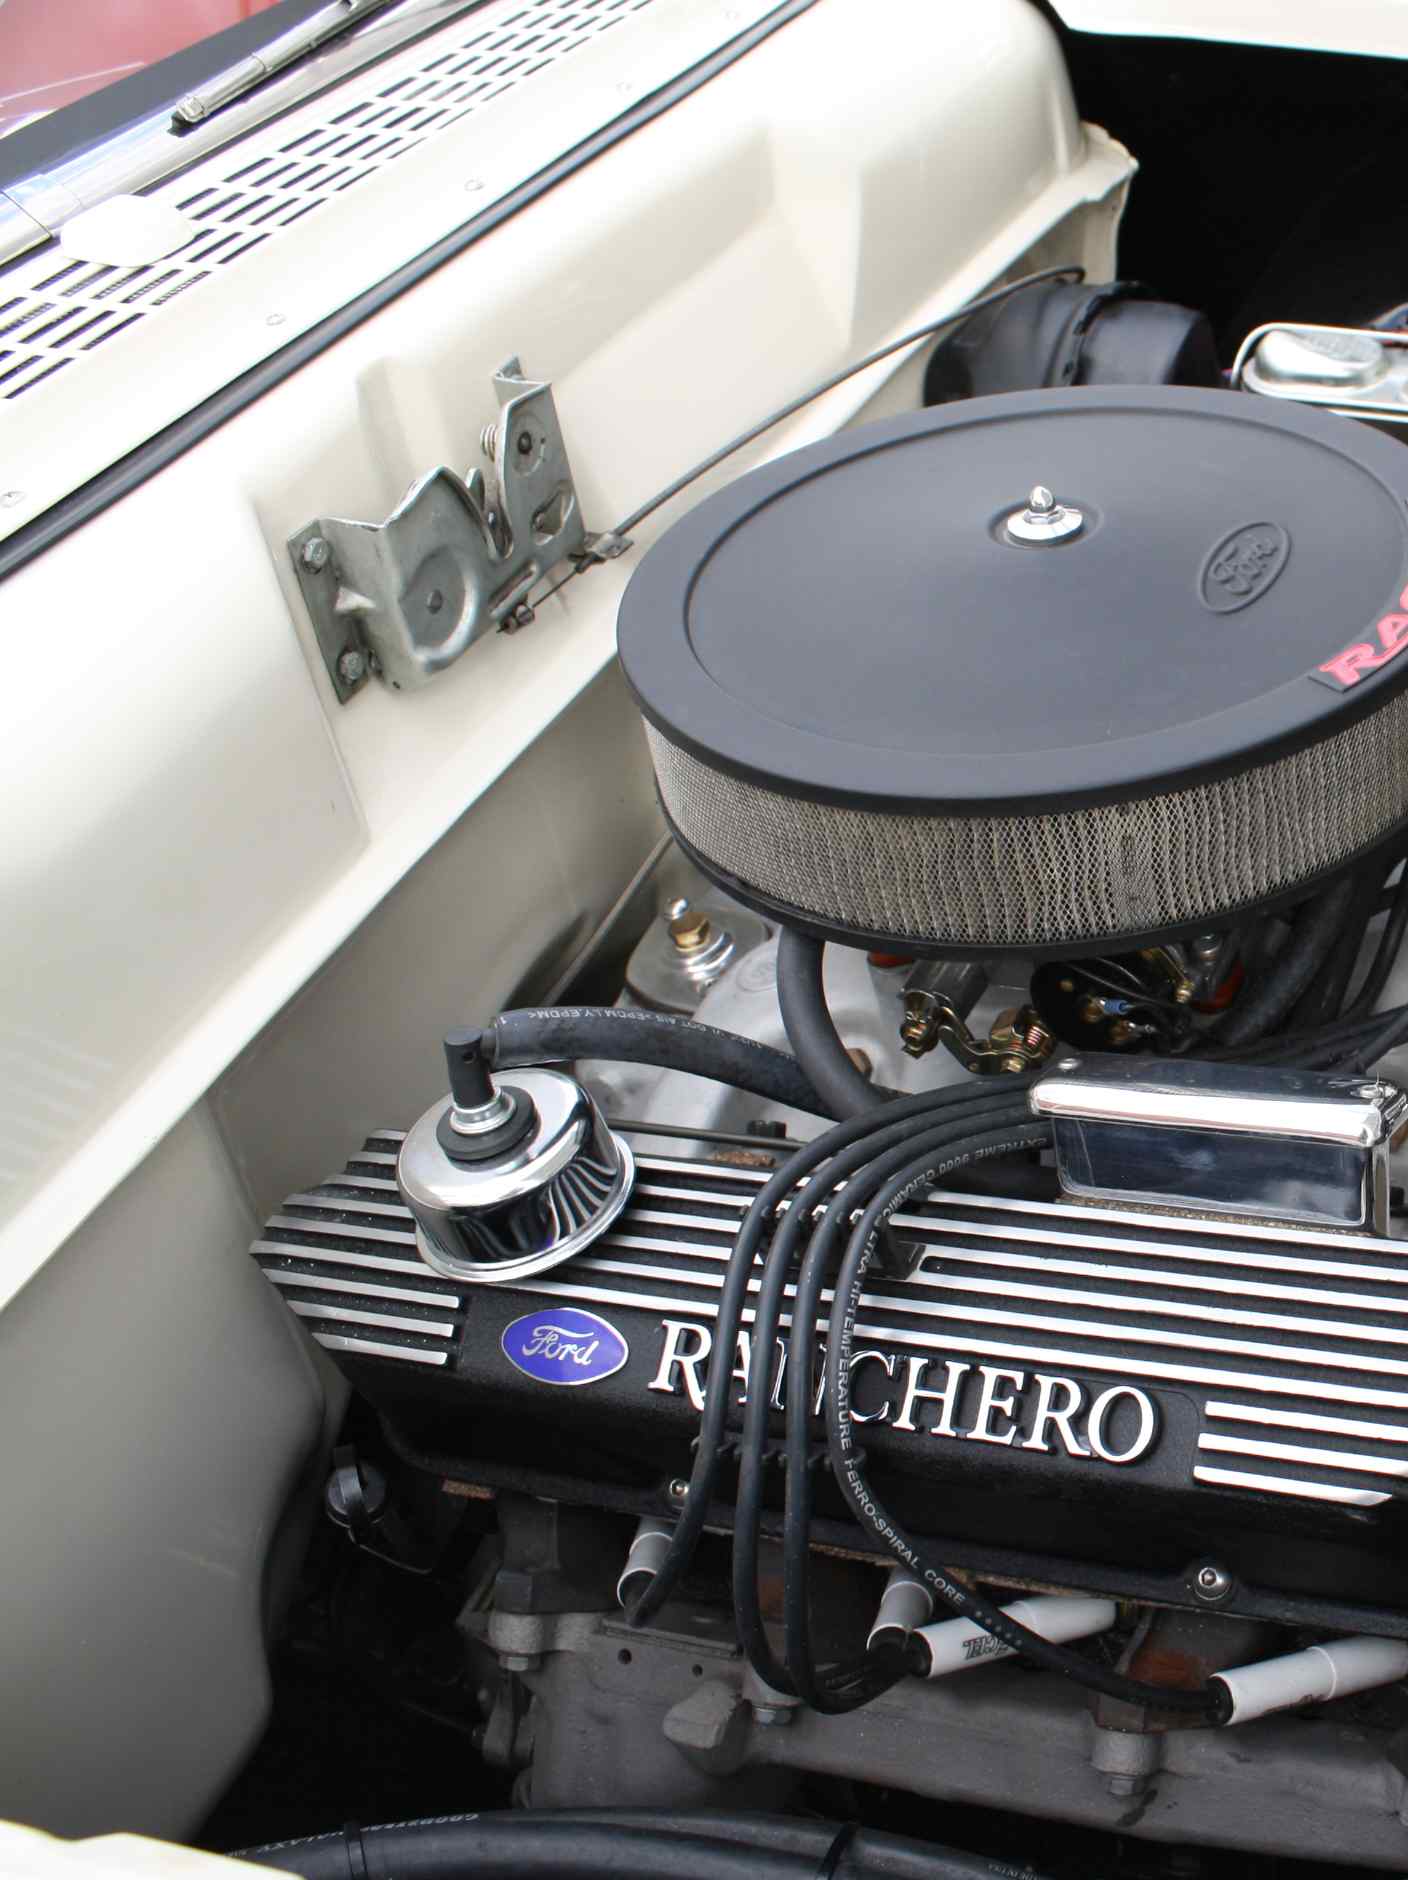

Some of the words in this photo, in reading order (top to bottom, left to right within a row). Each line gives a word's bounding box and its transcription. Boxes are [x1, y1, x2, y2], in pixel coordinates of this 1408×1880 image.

[521, 1324, 600, 1367] Ford
[843, 1457, 921, 1569] FERRO-SPIRAL
[923, 1569, 966, 1605] CORE
